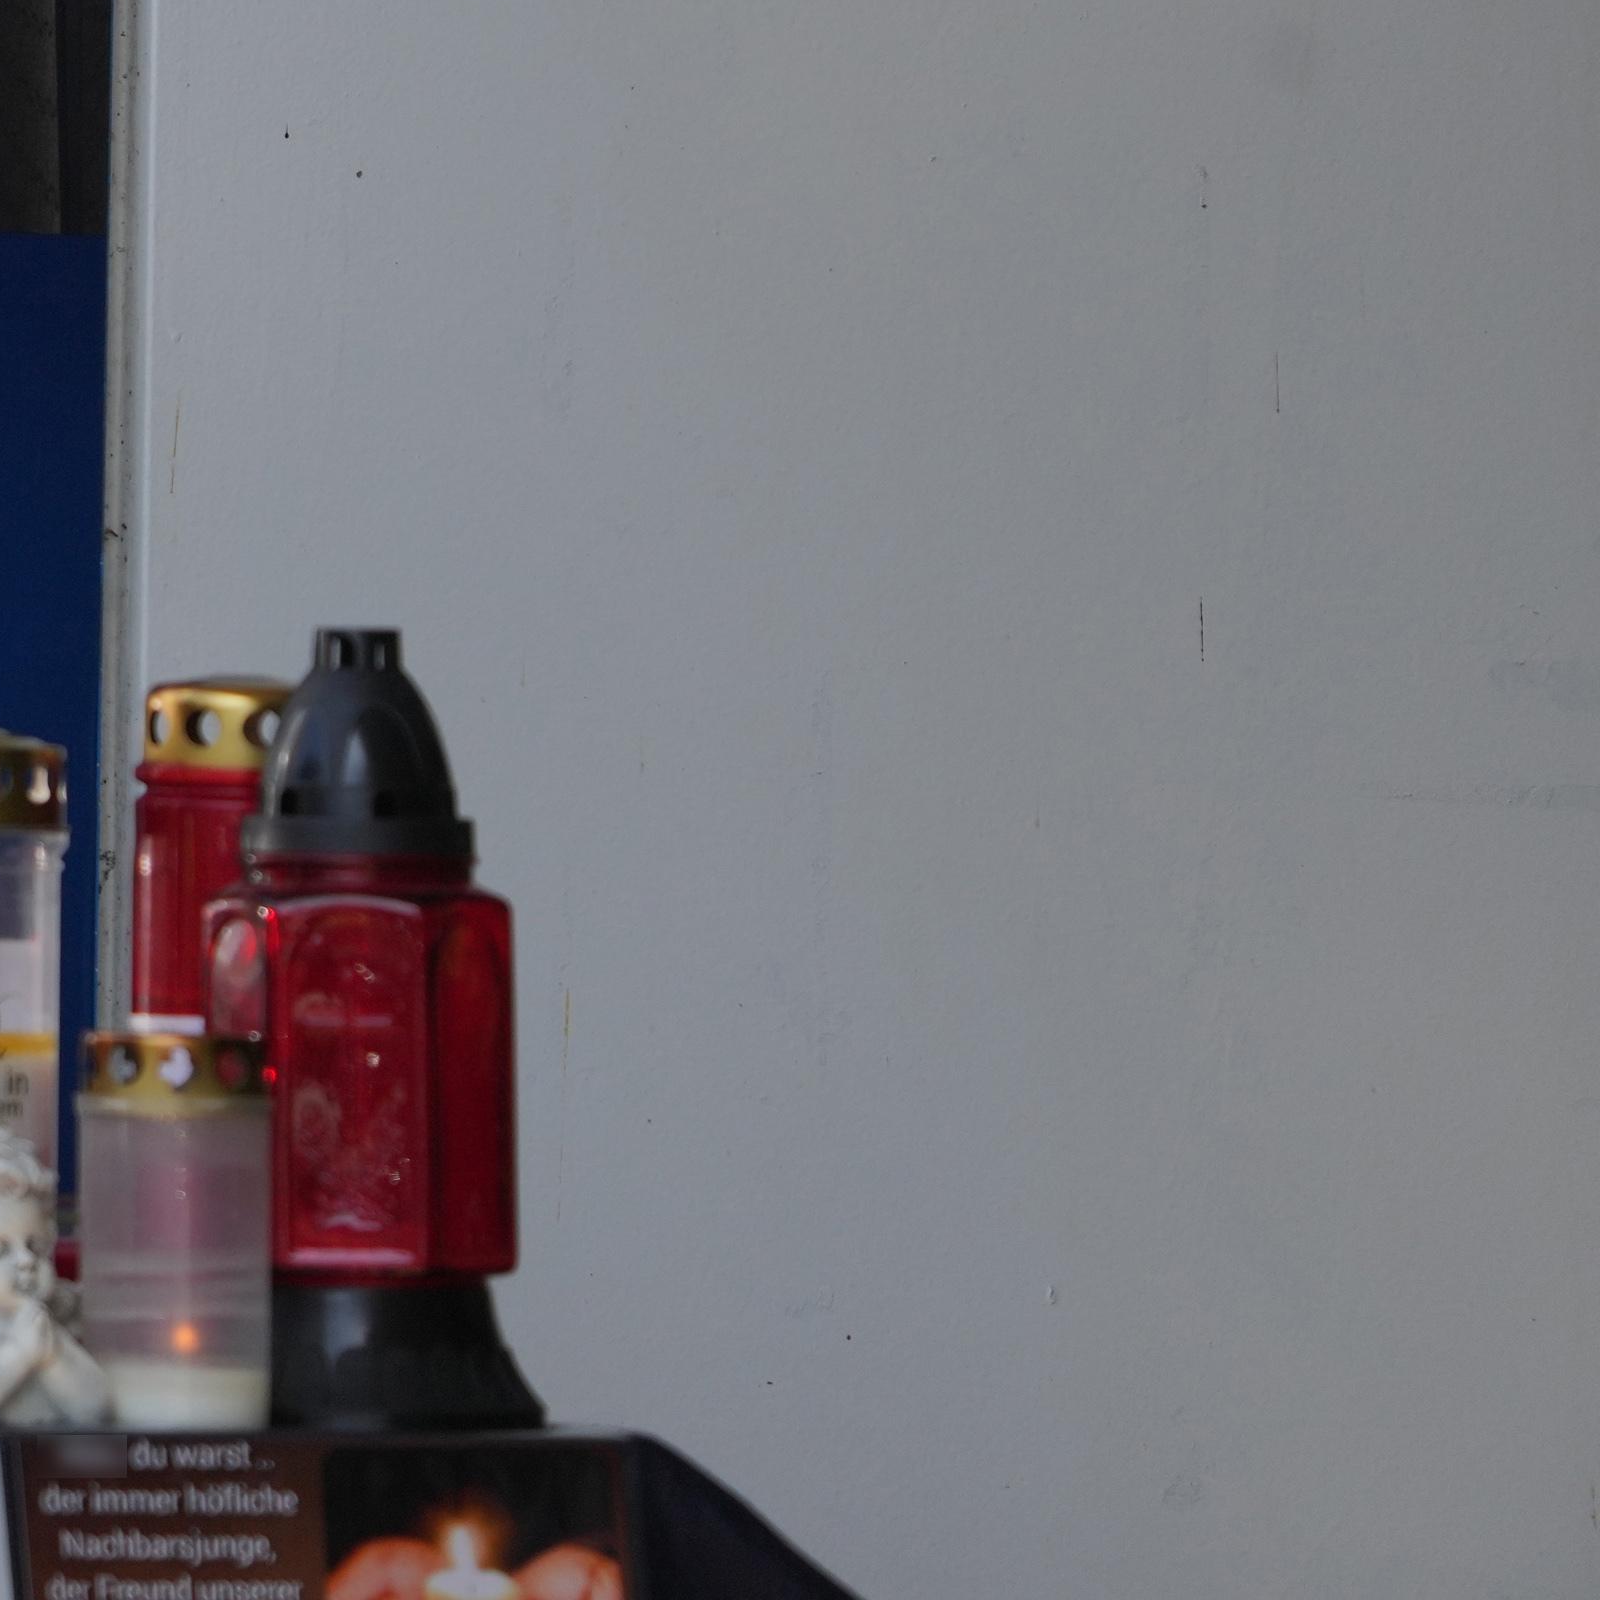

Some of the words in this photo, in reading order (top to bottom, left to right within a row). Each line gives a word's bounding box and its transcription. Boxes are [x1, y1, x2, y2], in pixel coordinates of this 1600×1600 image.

[6, 1067, 31, 1096] in
[127, 1435, 169, 1472] du
[38, 1480, 86, 1517] der
[87, 1480, 183, 1516] immer
[182, 1479, 300, 1517] höfliche
[44, 1570, 91, 1600] der
[92, 1571, 193, 1600] Freund
